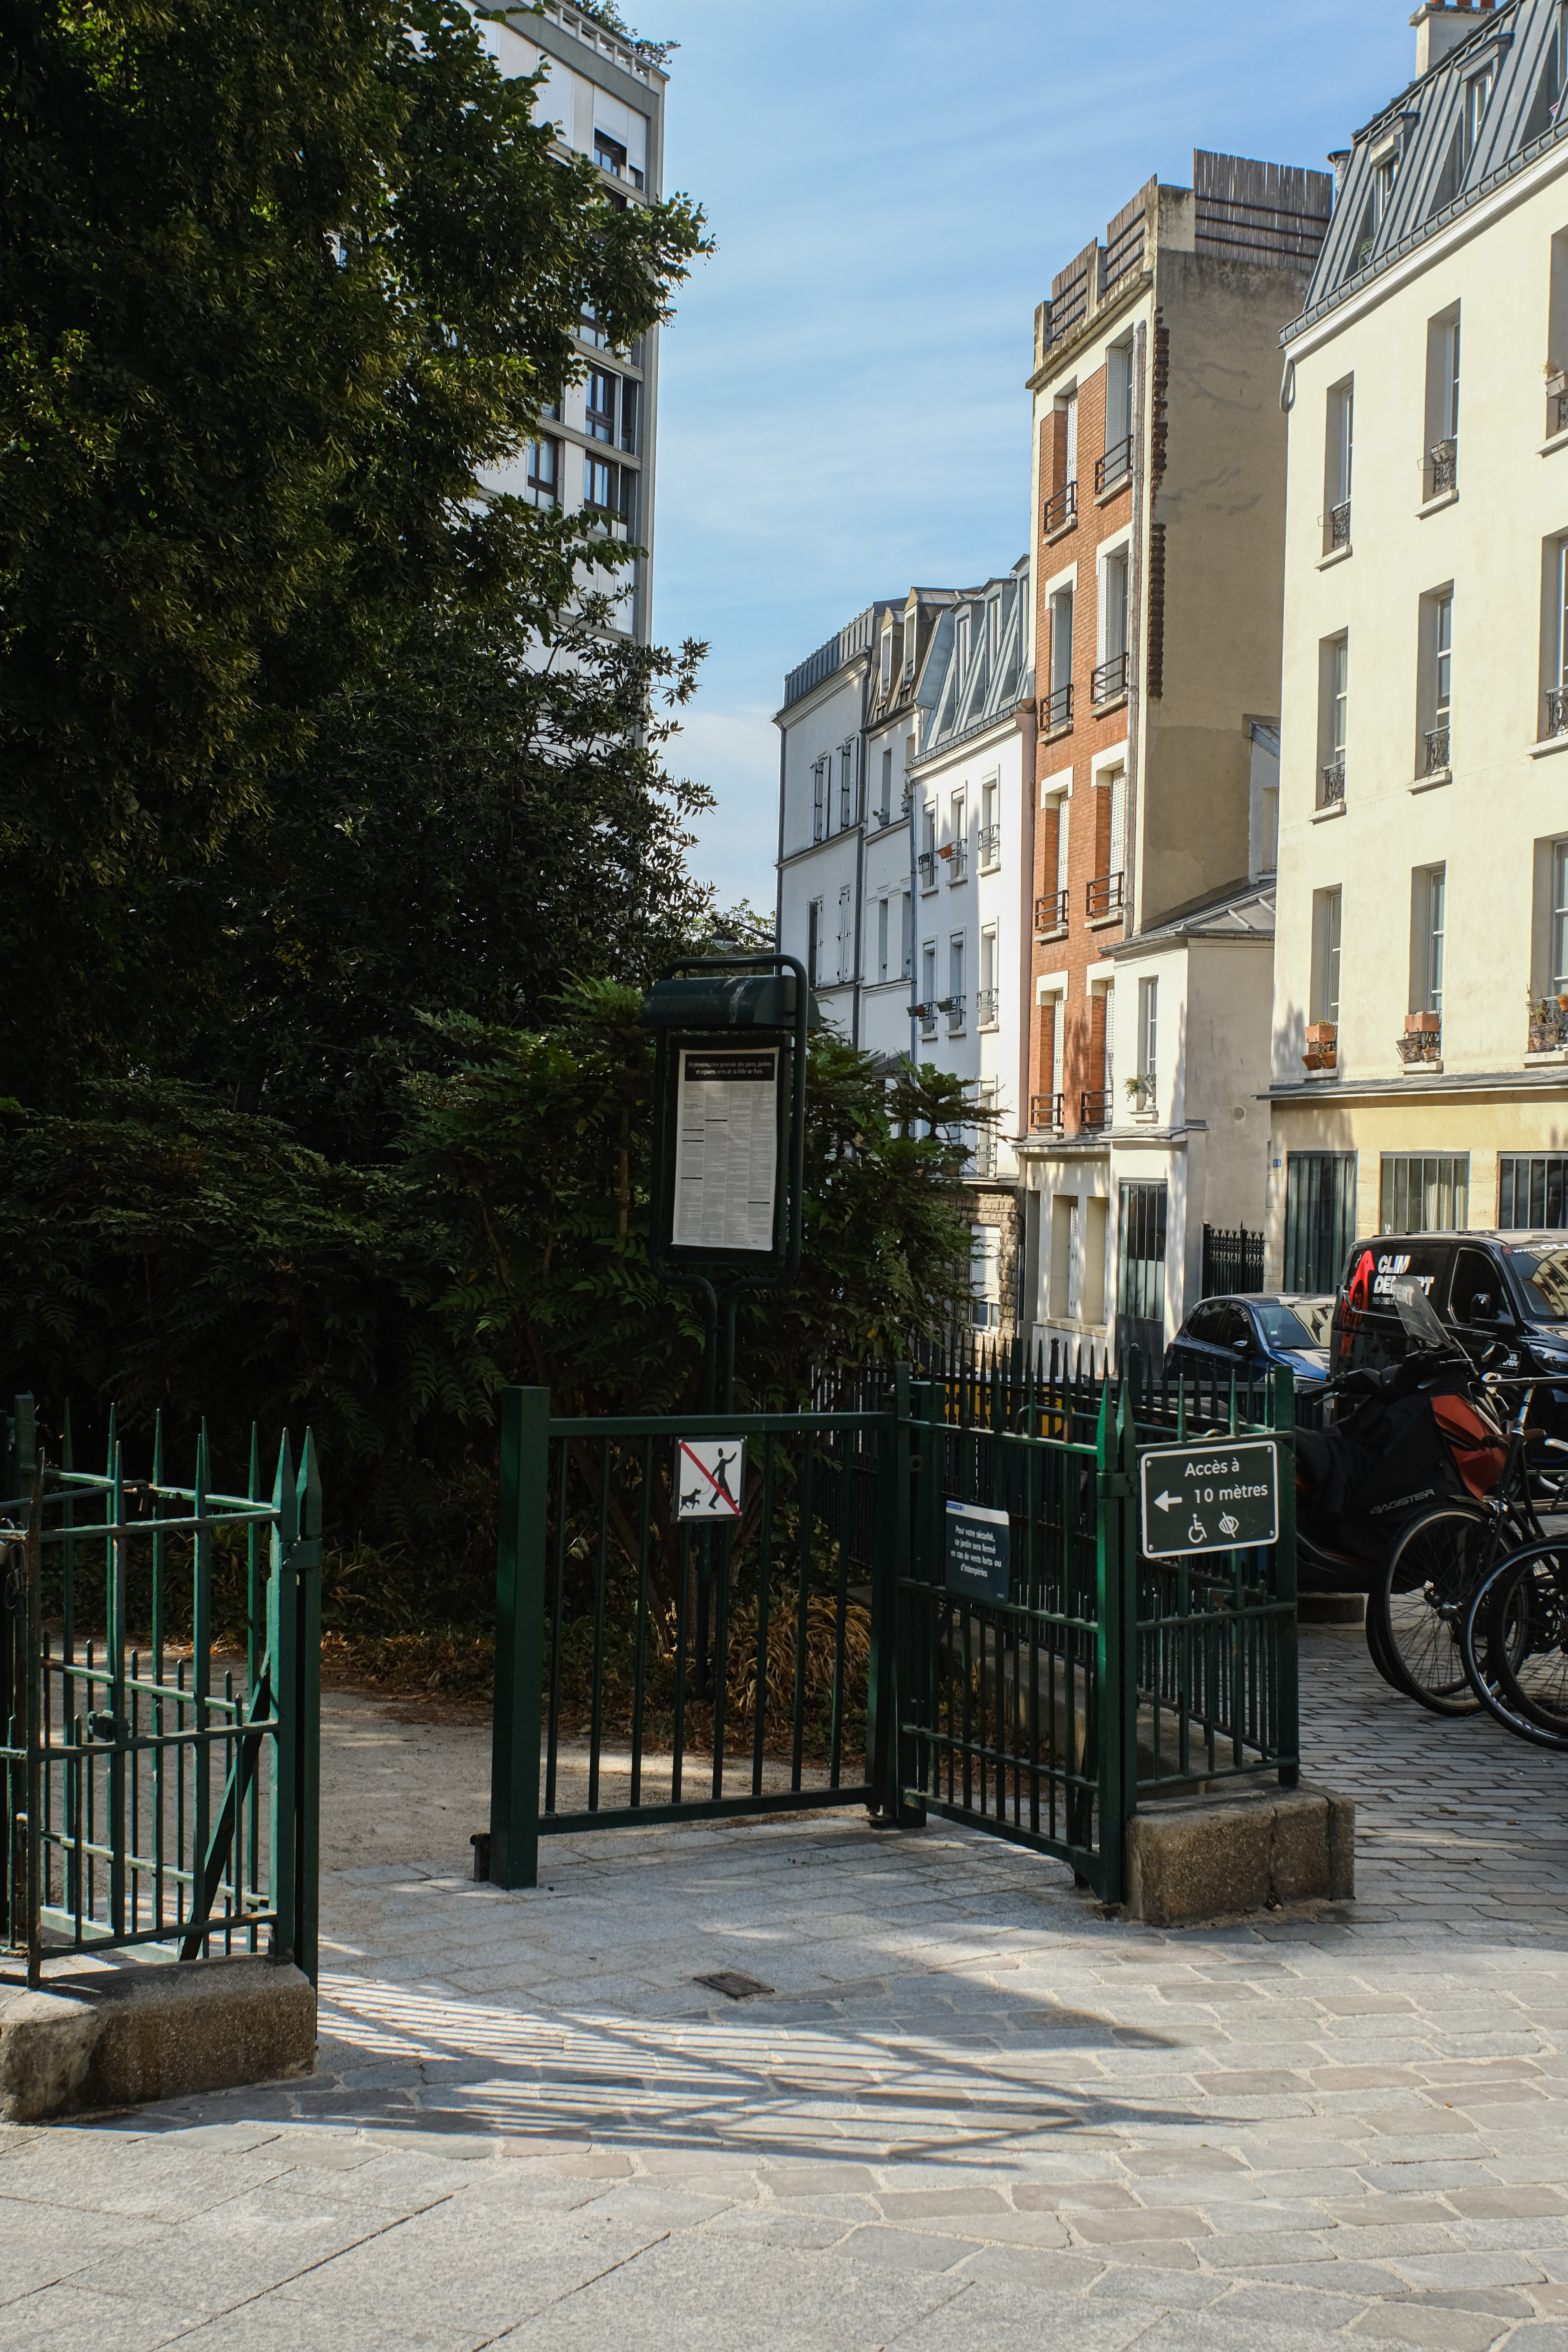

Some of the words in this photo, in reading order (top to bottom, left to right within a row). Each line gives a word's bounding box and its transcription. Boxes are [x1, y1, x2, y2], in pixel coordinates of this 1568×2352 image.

[1378, 1255, 1411, 1274] CLIM
[1185, 1460, 1228, 1477] Accès
[1232, 1458, 1239, 1472] à
[1195, 1488, 1214, 1503] 10
[1219, 1484, 1268, 1501] mètres
[1370, 1489, 1436, 1515] BAGSTER
[956, 1525, 964, 1534] Pour
[965, 1528, 975, 1537] votre
[976, 1530, 995, 1542] sécurité,
[960, 1538, 971, 1548] jardin
[982, 1544, 996, 1554] fermé
[964, 1552, 969, 1560] de
[971, 1554, 981, 1563] vents
[982, 1556, 993, 1566] forts
[960, 1563, 987, 1577] d'intempéries
